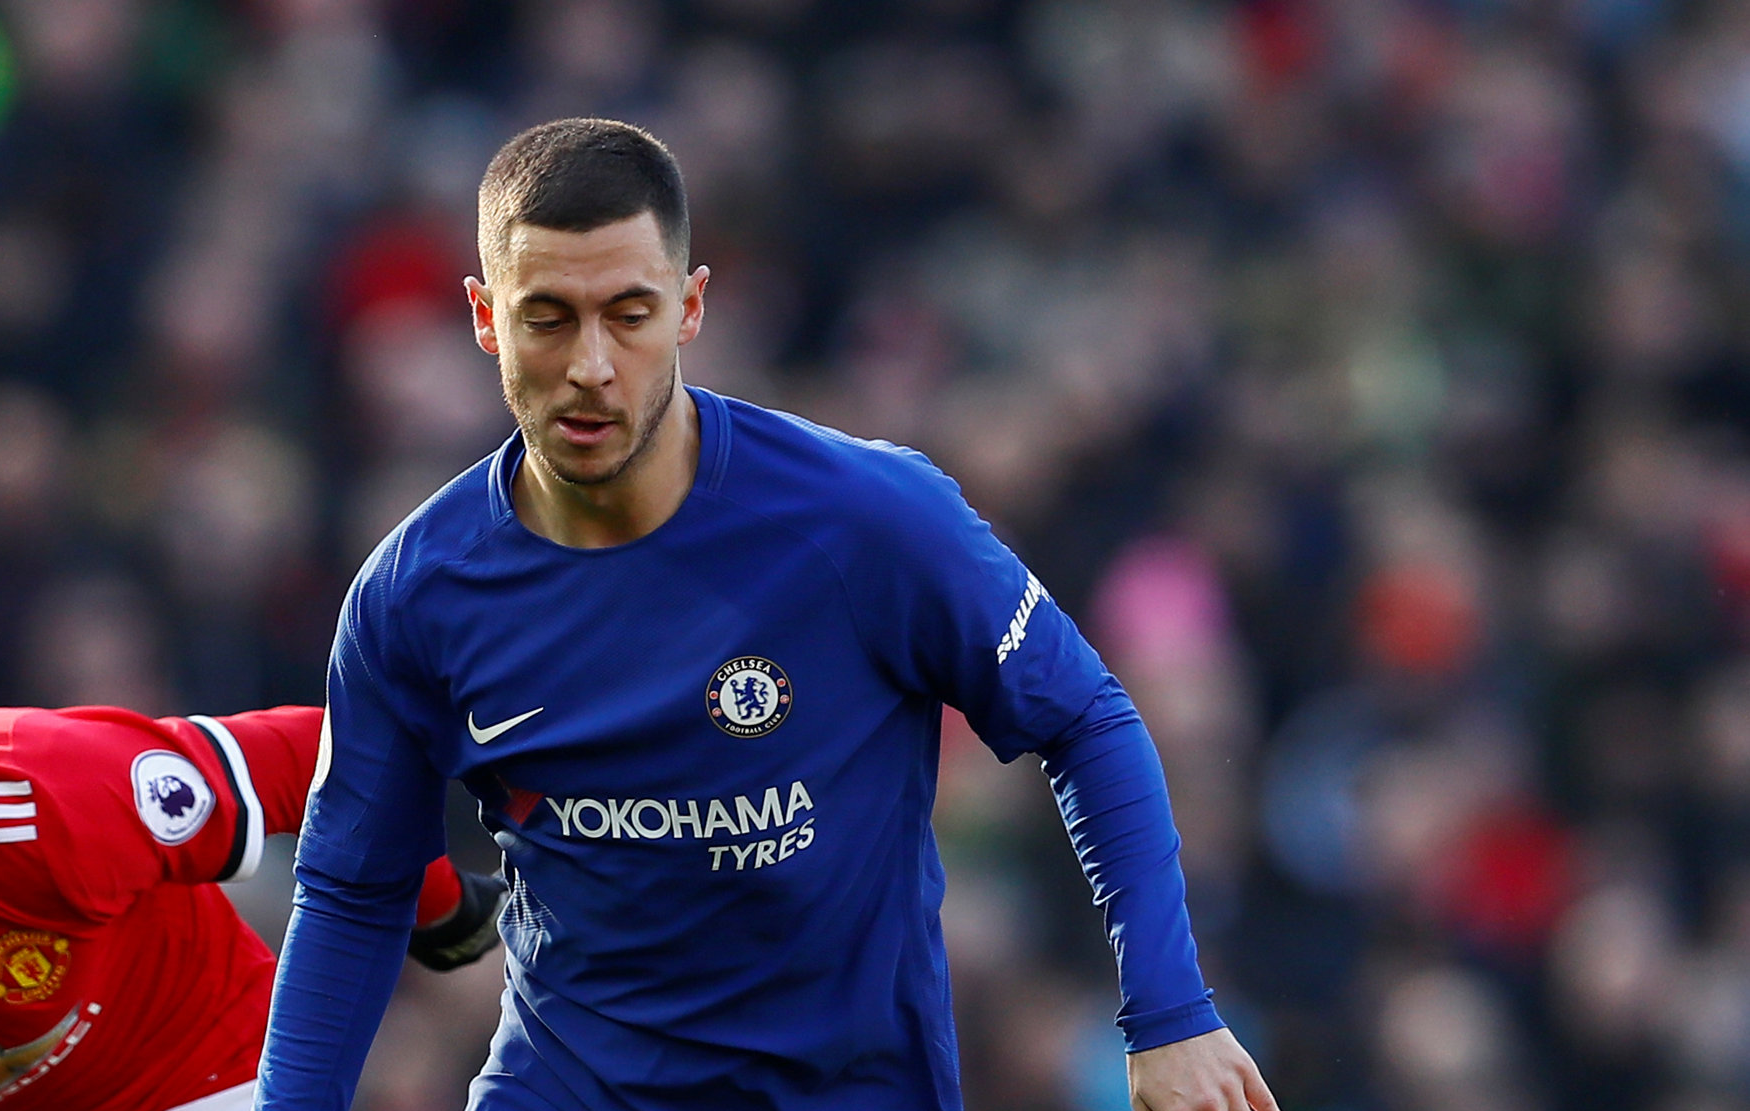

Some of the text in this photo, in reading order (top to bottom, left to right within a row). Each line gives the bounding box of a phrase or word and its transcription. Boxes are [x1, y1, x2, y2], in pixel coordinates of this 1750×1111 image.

[717, 659, 771, 682] CHELSEA
[725, 713, 782, 735] FOOTBALL CLUB
[545, 780, 814, 839] YOKOHAMA
[707, 818, 815, 871] TYRES
